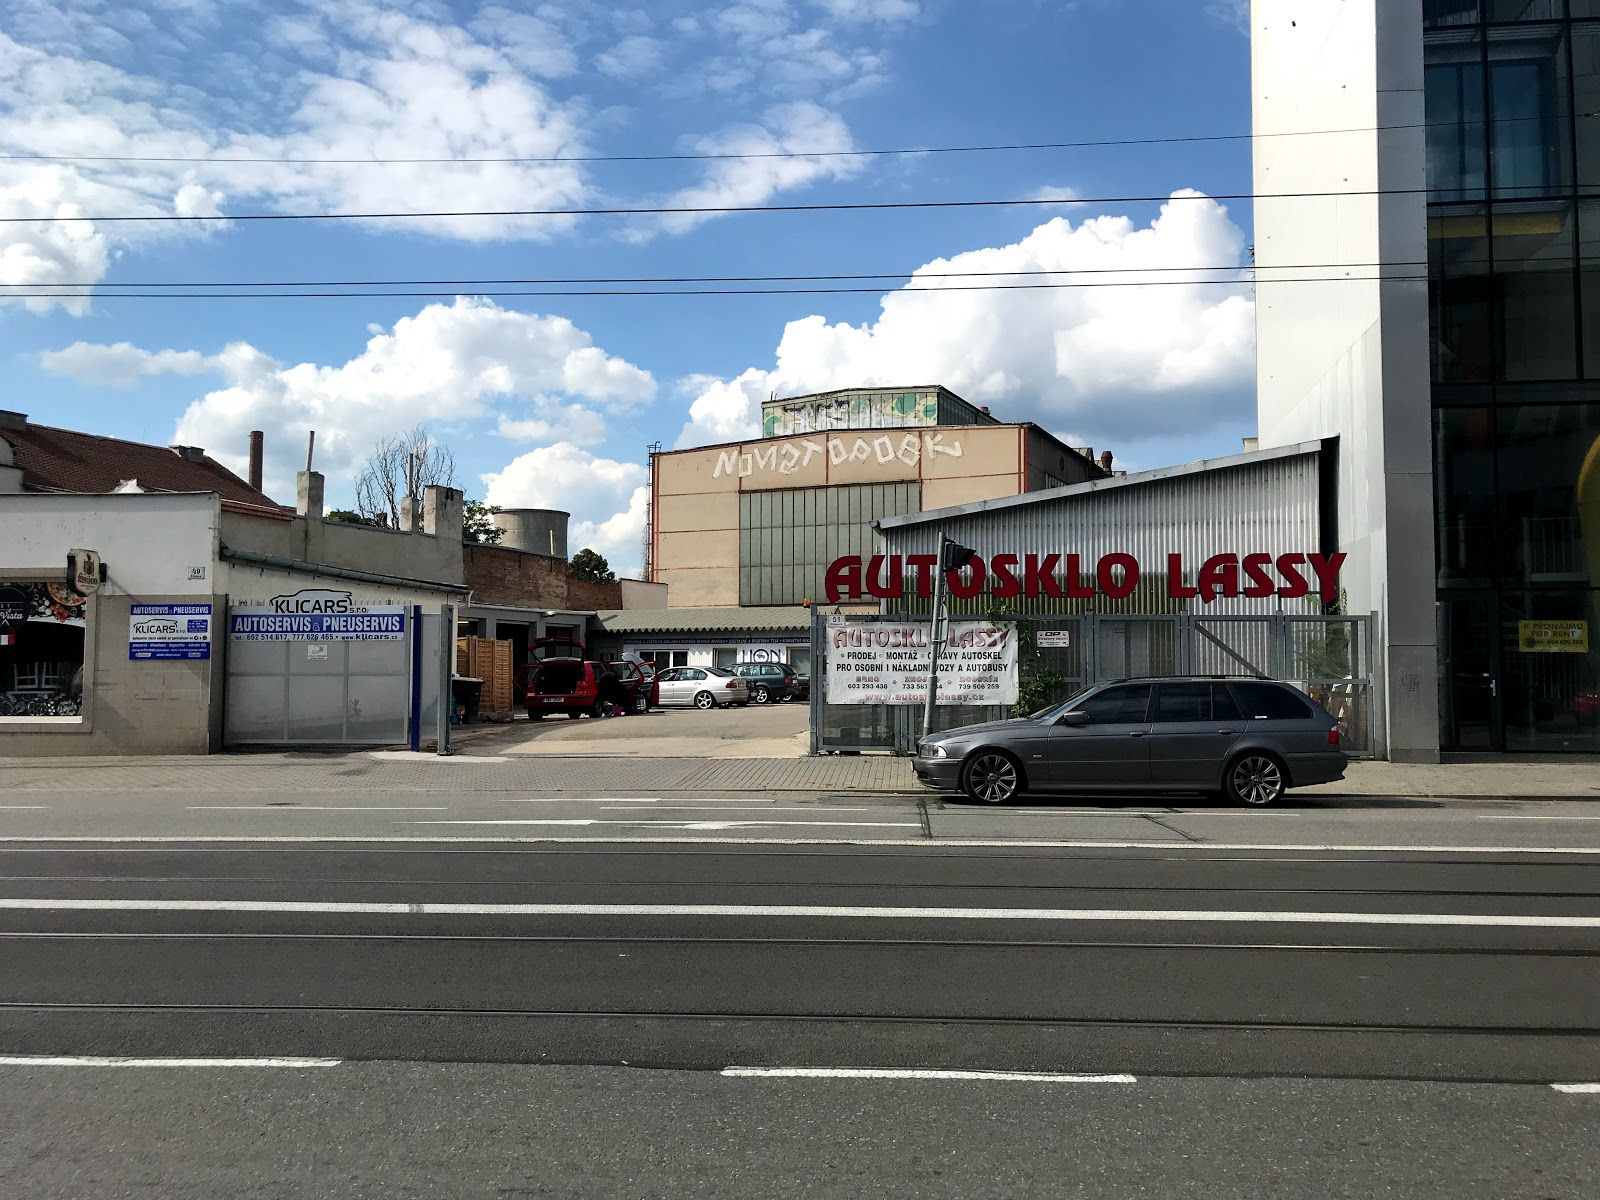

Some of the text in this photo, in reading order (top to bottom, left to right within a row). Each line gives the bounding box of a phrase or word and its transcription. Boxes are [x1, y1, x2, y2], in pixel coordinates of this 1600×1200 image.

[825, 551, 1348, 605] AUTOSKLO LASSY
[133, 606, 169, 614] AUTOSERVIS
[173, 606, 209, 614] PNEUSERVIS
[274, 599, 348, 614] KLICARS
[135, 625, 176, 634] KLICARS
[235, 616, 400, 632] AUTOSERVIS & PNEUSERVIS
[246, 633, 259, 641] 602
[260, 633, 273, 641] 514
[292, 633, 305, 641] 777
[306, 633, 319, 641] 626
[341, 633, 398, 641] www.klicars.cz
[833, 628, 932, 649] AUTOSKL
[847, 650, 1003, 661] PRODEJ MONTÁŽ ORAVY AUTOSKEL
[836, 663, 852, 672] PRO
[854, 661, 883, 672] OSOBNÍ
[957, 663, 964, 672] A
[966, 663, 1008, 672] AUTOBUSY
